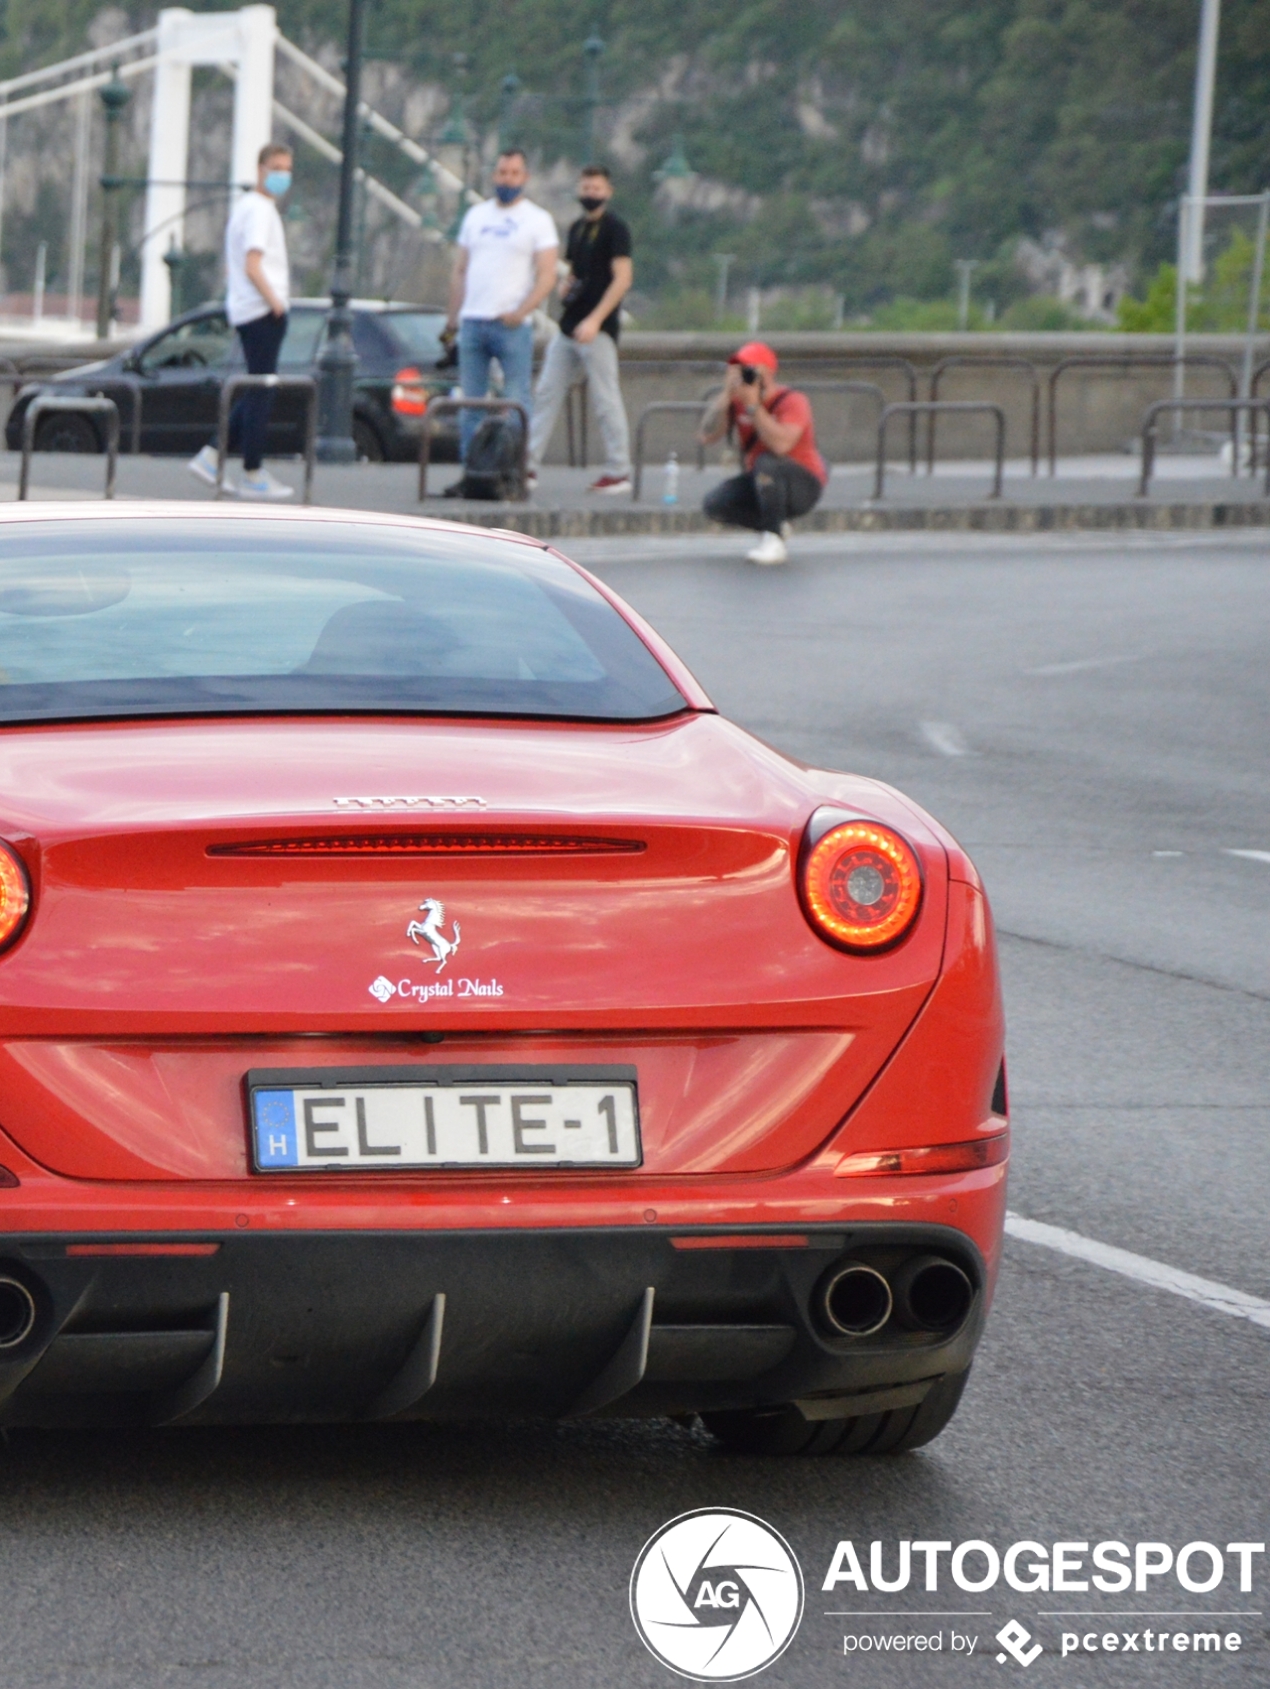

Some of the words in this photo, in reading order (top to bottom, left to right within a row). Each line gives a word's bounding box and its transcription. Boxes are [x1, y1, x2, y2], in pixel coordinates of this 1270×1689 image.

[397, 979, 454, 1003] Crystal
[457, 978, 504, 997] Nails
[303, 1094, 620, 1157] ELITE-1
[269, 1134, 288, 1156] H
